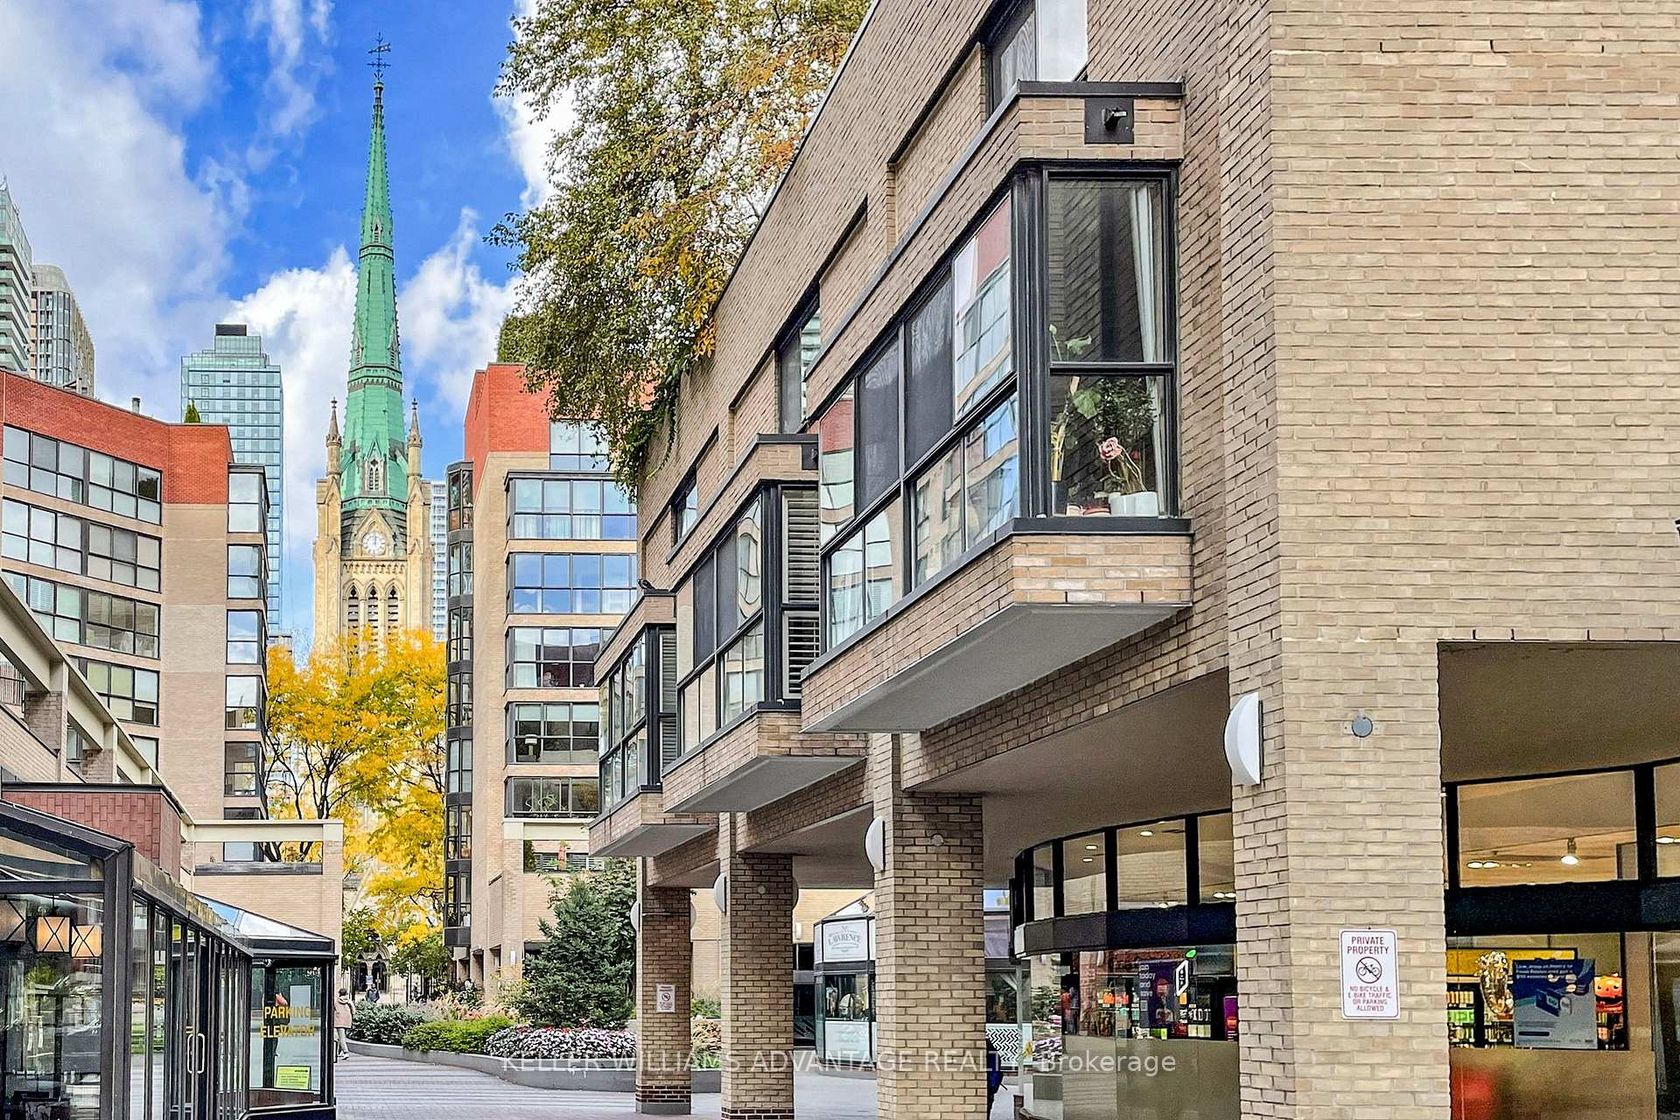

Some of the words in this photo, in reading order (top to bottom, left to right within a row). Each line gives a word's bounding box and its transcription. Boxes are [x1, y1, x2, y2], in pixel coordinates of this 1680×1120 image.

[1351, 936, 1384, 945] PRIVATE
[1347, 946, 1389, 955] PROPERTY
[1139, 972, 1156, 980] today
[264, 1006, 311, 1019] PARKING
[260, 1025, 315, 1038] ELEVATOR
